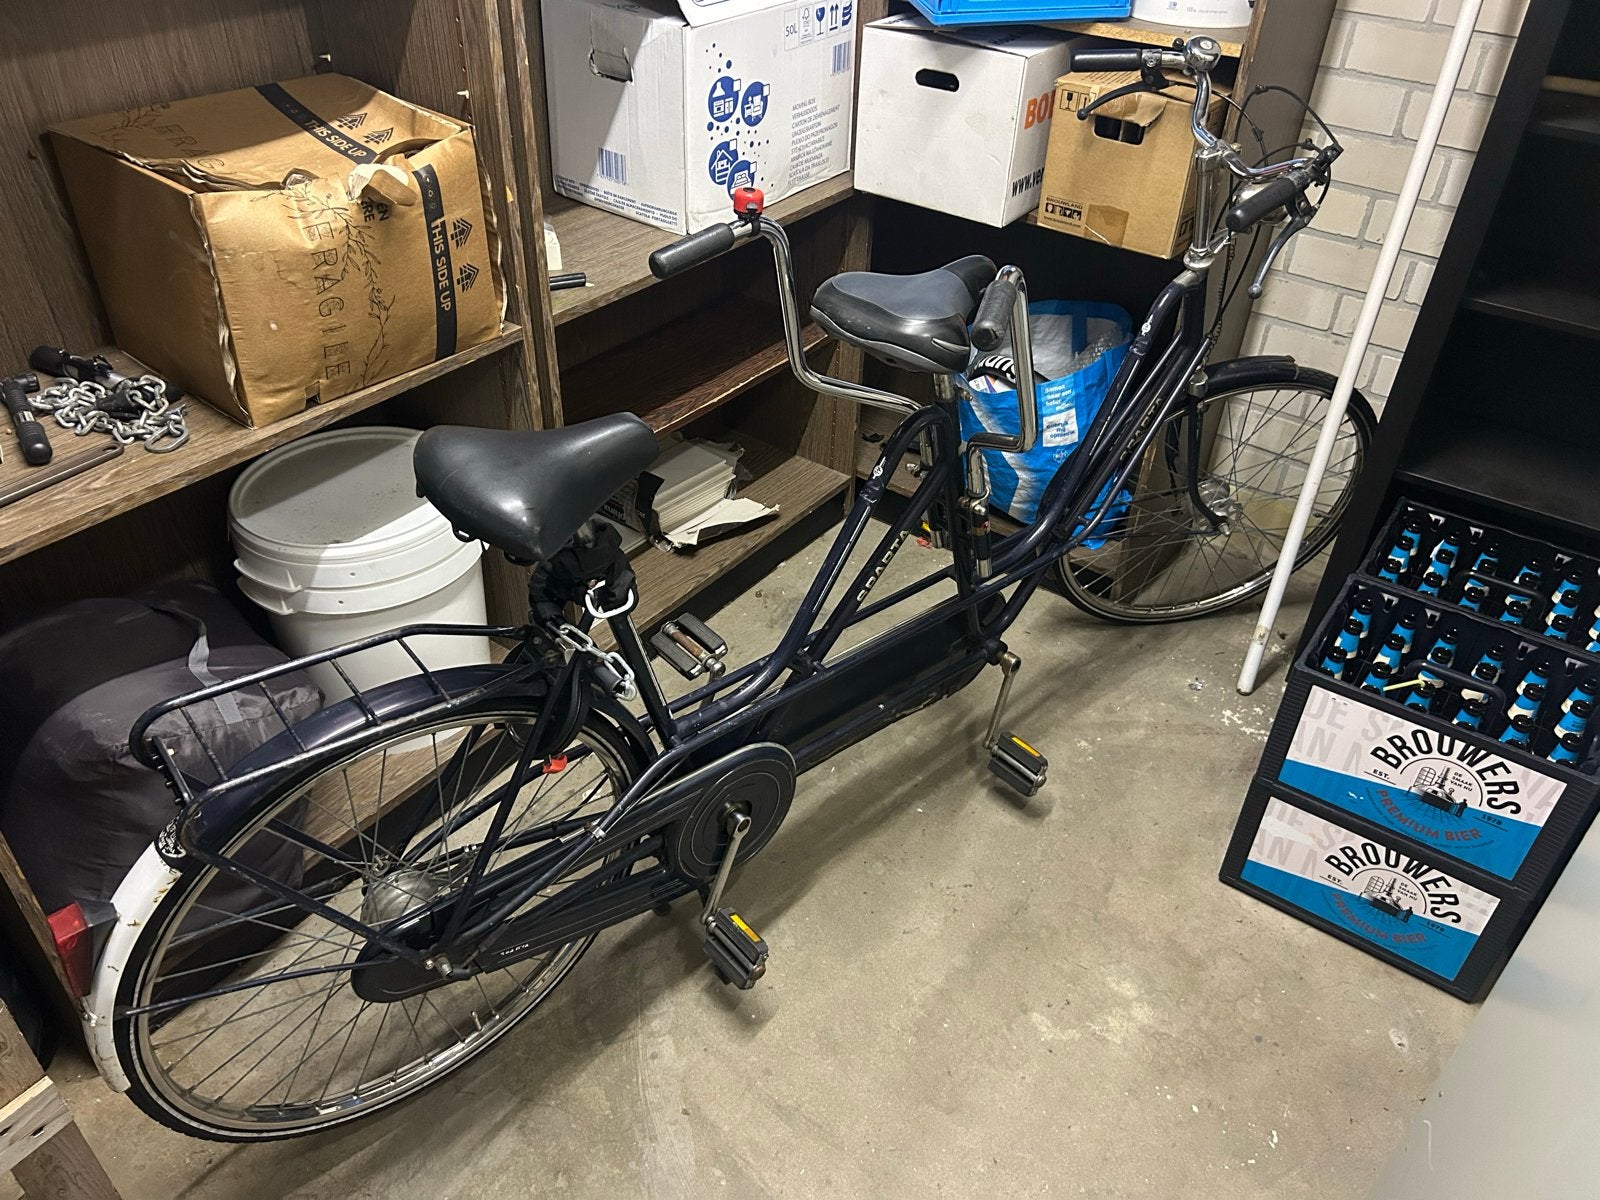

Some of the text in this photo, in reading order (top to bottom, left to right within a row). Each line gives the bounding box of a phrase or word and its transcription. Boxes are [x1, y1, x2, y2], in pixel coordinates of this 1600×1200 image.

[304, 119, 368, 158] THIS SIDE UP
[1045, 196, 1084, 210] BROUWLAND
[430, 216, 451, 312] THIS SIDE UP
[302, 221, 351, 380] FRAGILE
[856, 530, 910, 602] SPARTA
[1370, 729, 1522, 815] BROUWERS
[1372, 768, 1391, 781] EST.
[1450, 780, 1463, 788] VAN
[1376, 788, 1440, 842] PREMIUM
[1443, 827, 1483, 842] BIER
[1480, 813, 1504, 827] 1978
[1324, 842, 1462, 924] BROUWERS
[1327, 873, 1343, 885] EST.
[1330, 892, 1389, 940] PREMIUM
[1392, 930, 1426, 944] BIER
